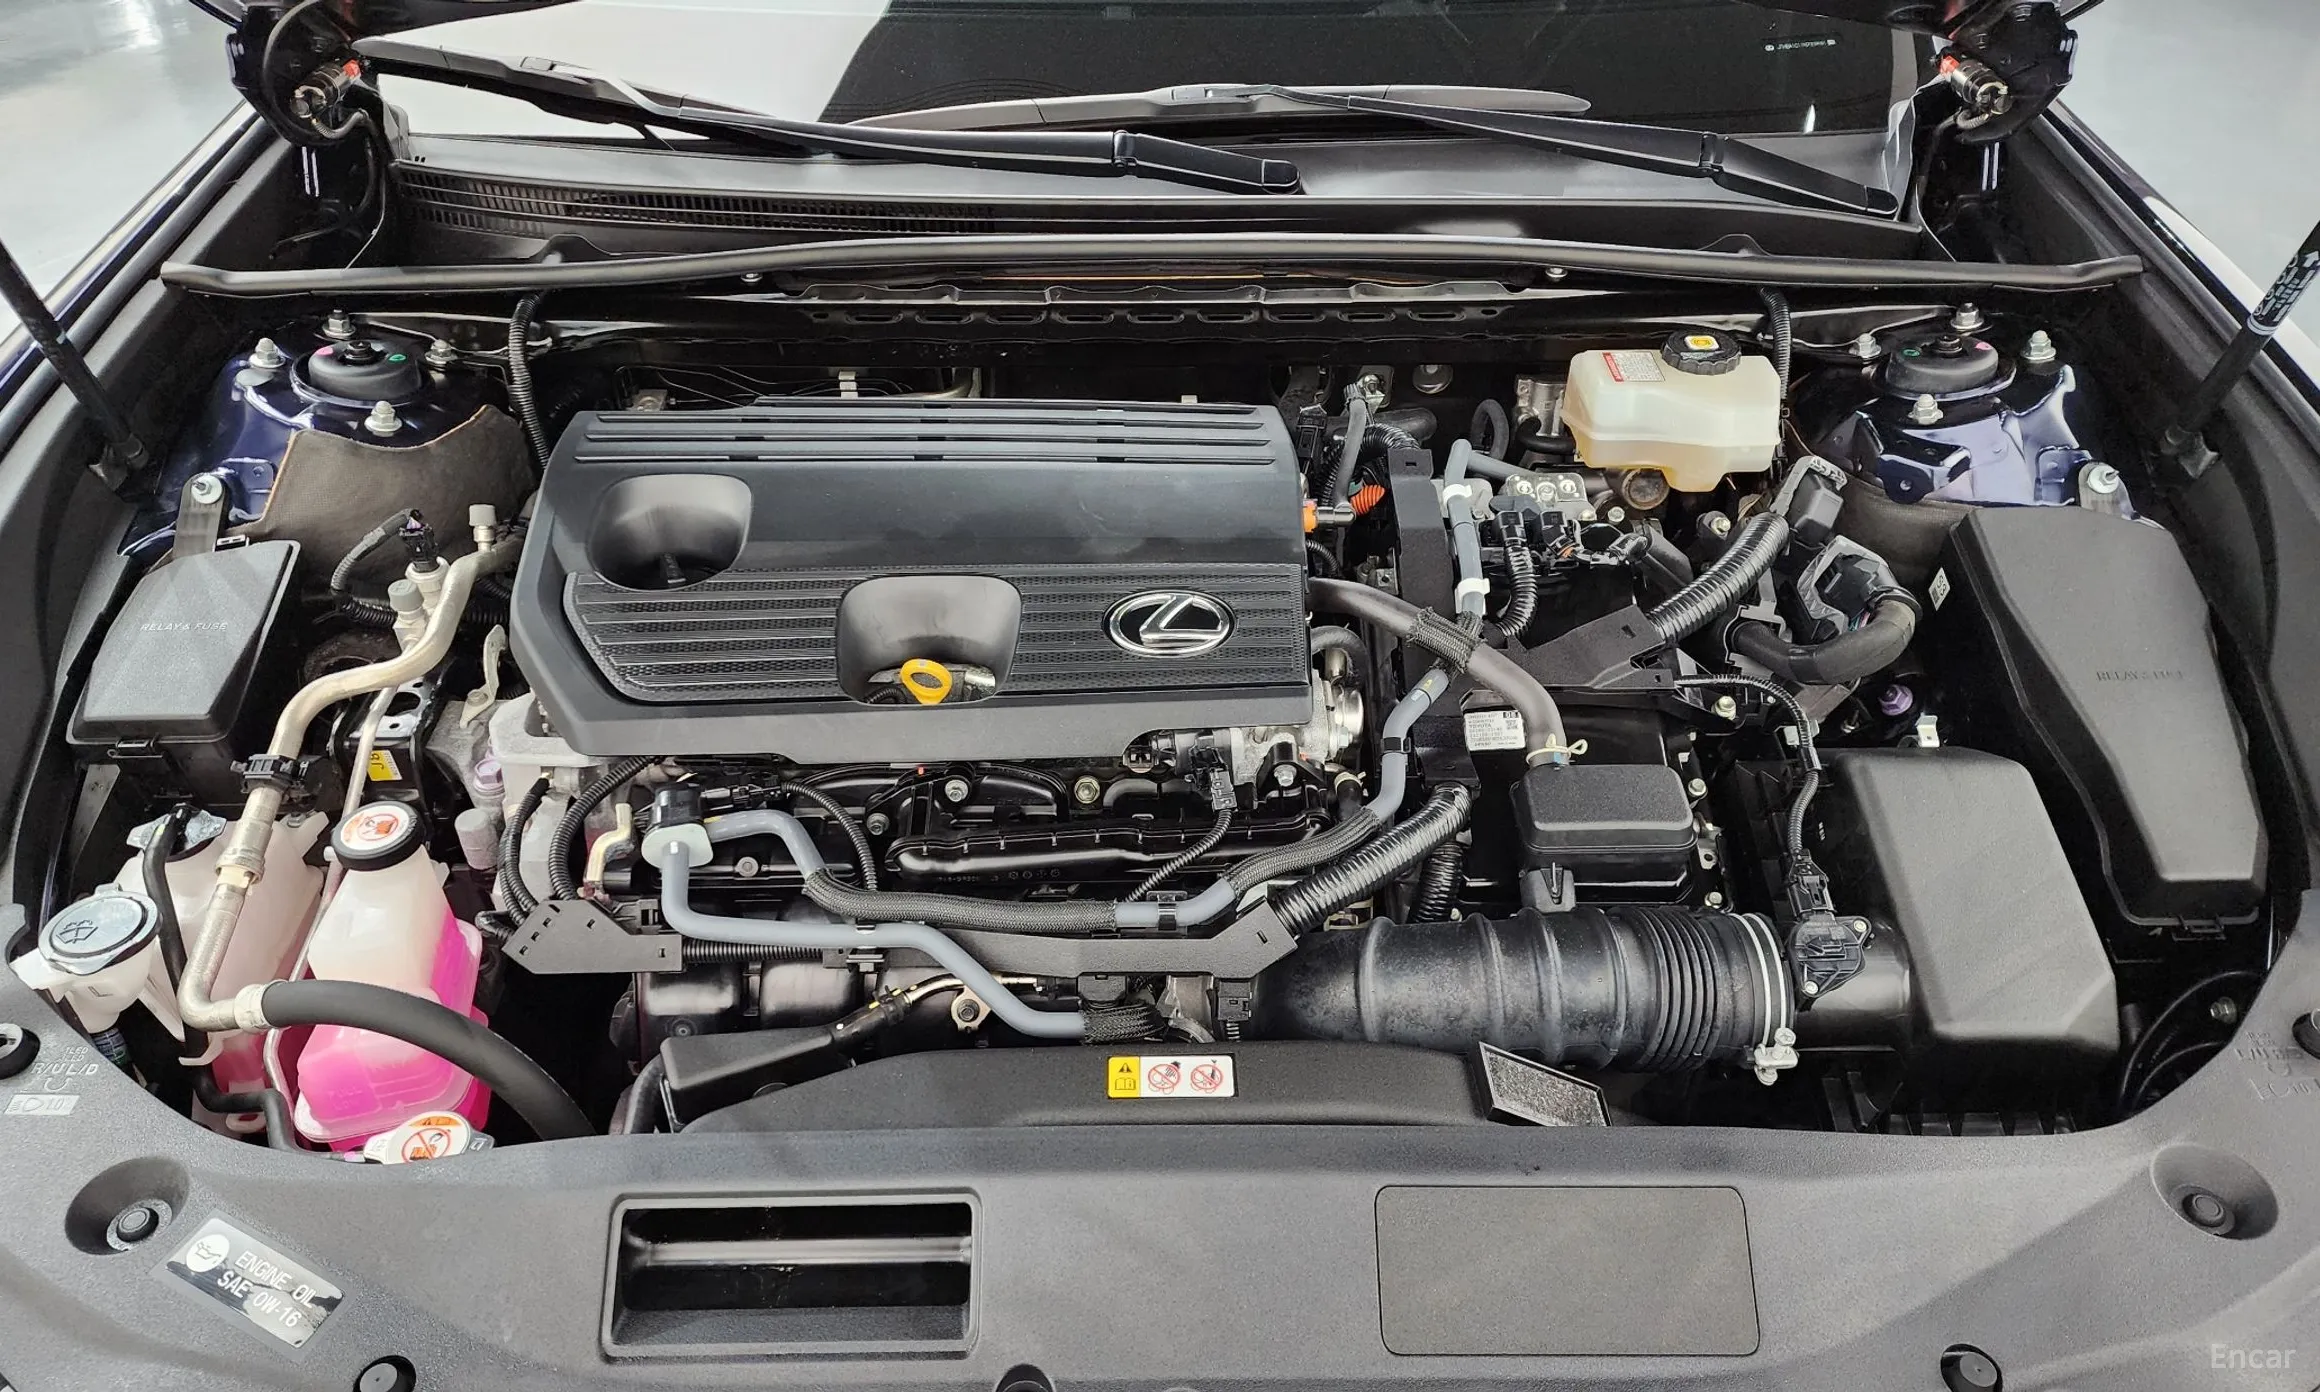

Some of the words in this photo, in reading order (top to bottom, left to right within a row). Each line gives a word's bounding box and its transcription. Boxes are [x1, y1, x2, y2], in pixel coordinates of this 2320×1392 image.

[140, 622, 183, 632] RELAY
[194, 622, 229, 632] FUSE
[216, 1270, 254, 1299] SAE
[234, 1250, 293, 1291] ENGINE
[292, 1283, 318, 1309] OIL
